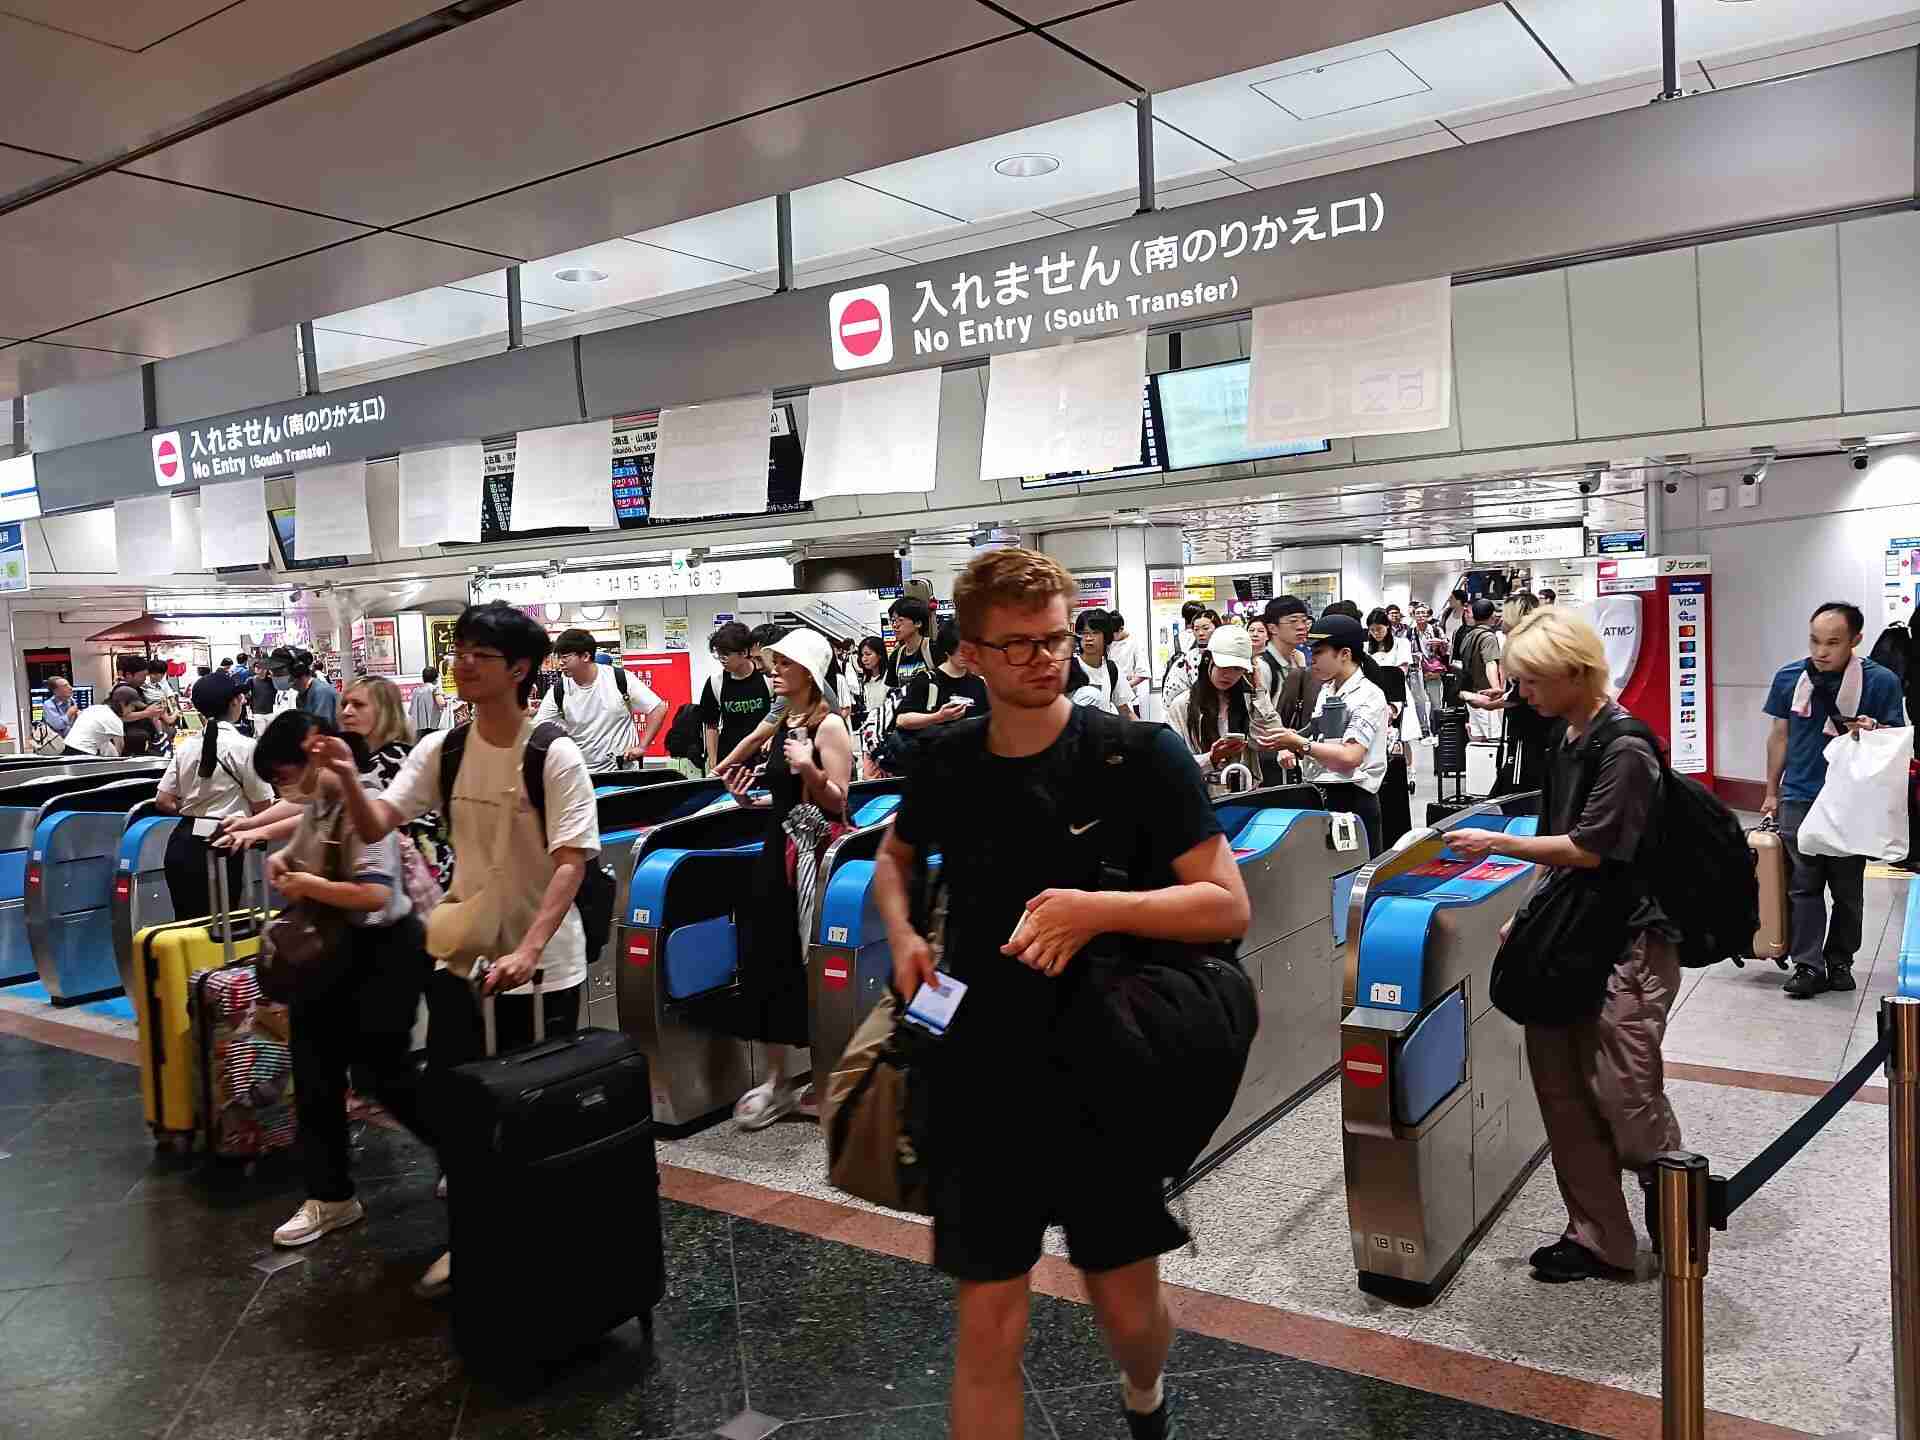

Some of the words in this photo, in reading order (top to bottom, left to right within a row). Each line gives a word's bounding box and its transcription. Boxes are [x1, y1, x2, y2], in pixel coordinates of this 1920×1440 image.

[912, 192, 1385, 323] 入れません（南のりかえ口）
[914, 327, 949, 354] No
[959, 314, 1033, 344] Entry
[1044, 304, 1118, 333] (South
[1127, 275, 1239, 317] Transfer)
[189, 395, 386, 459] 入れません（南のりかえ口）
[192, 462, 210, 479] No
[213, 455, 246, 476] Entry
[250, 451, 283, 470] (South
[286, 441, 331, 461] Transfer)
[1678, 599, 1697, 607] VISA
[725, 697, 762, 714] Kappa
